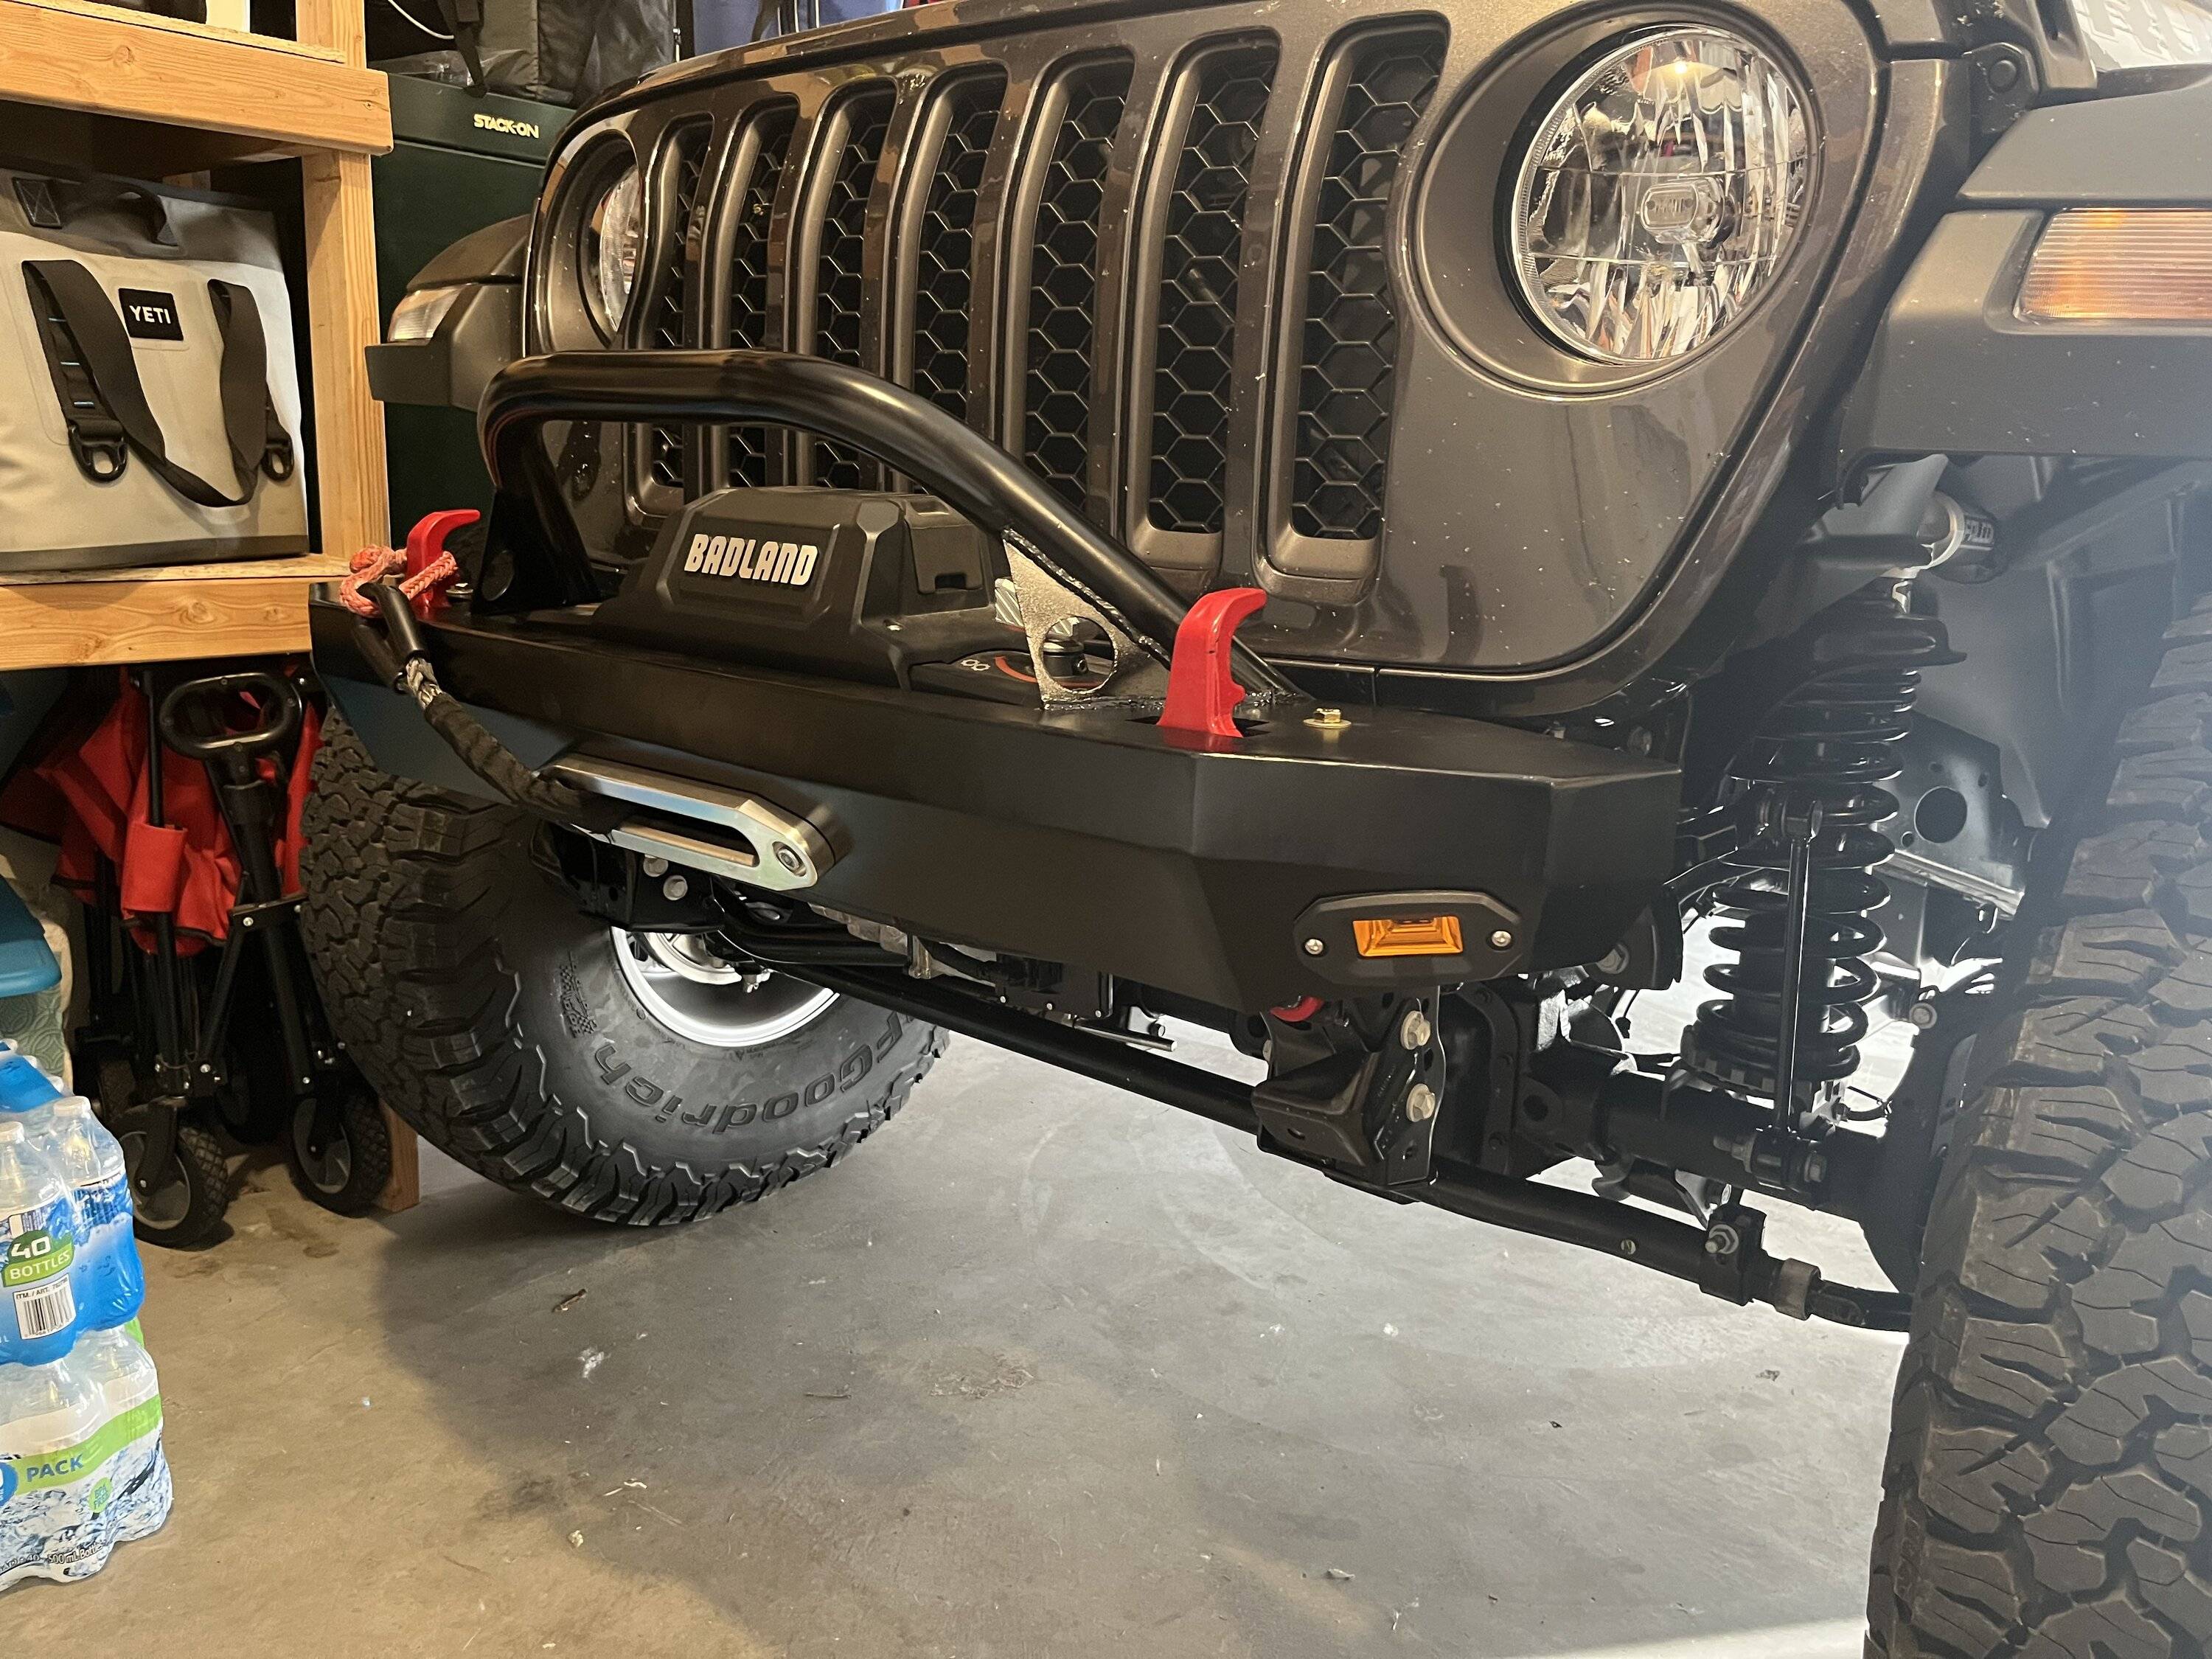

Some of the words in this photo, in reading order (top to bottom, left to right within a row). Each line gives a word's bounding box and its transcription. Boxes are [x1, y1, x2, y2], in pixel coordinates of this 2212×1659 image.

[473, 114, 539, 139] STACK-ON
[129, 305, 171, 324] YETI
[684, 534, 818, 585] BADLAND
[594, 1009, 911, 1134] FGoodrich
[11, 1236, 51, 1259] 40
[10, 1250, 70, 1279] BOTTLES
[27, 1454, 83, 1482] PACK
